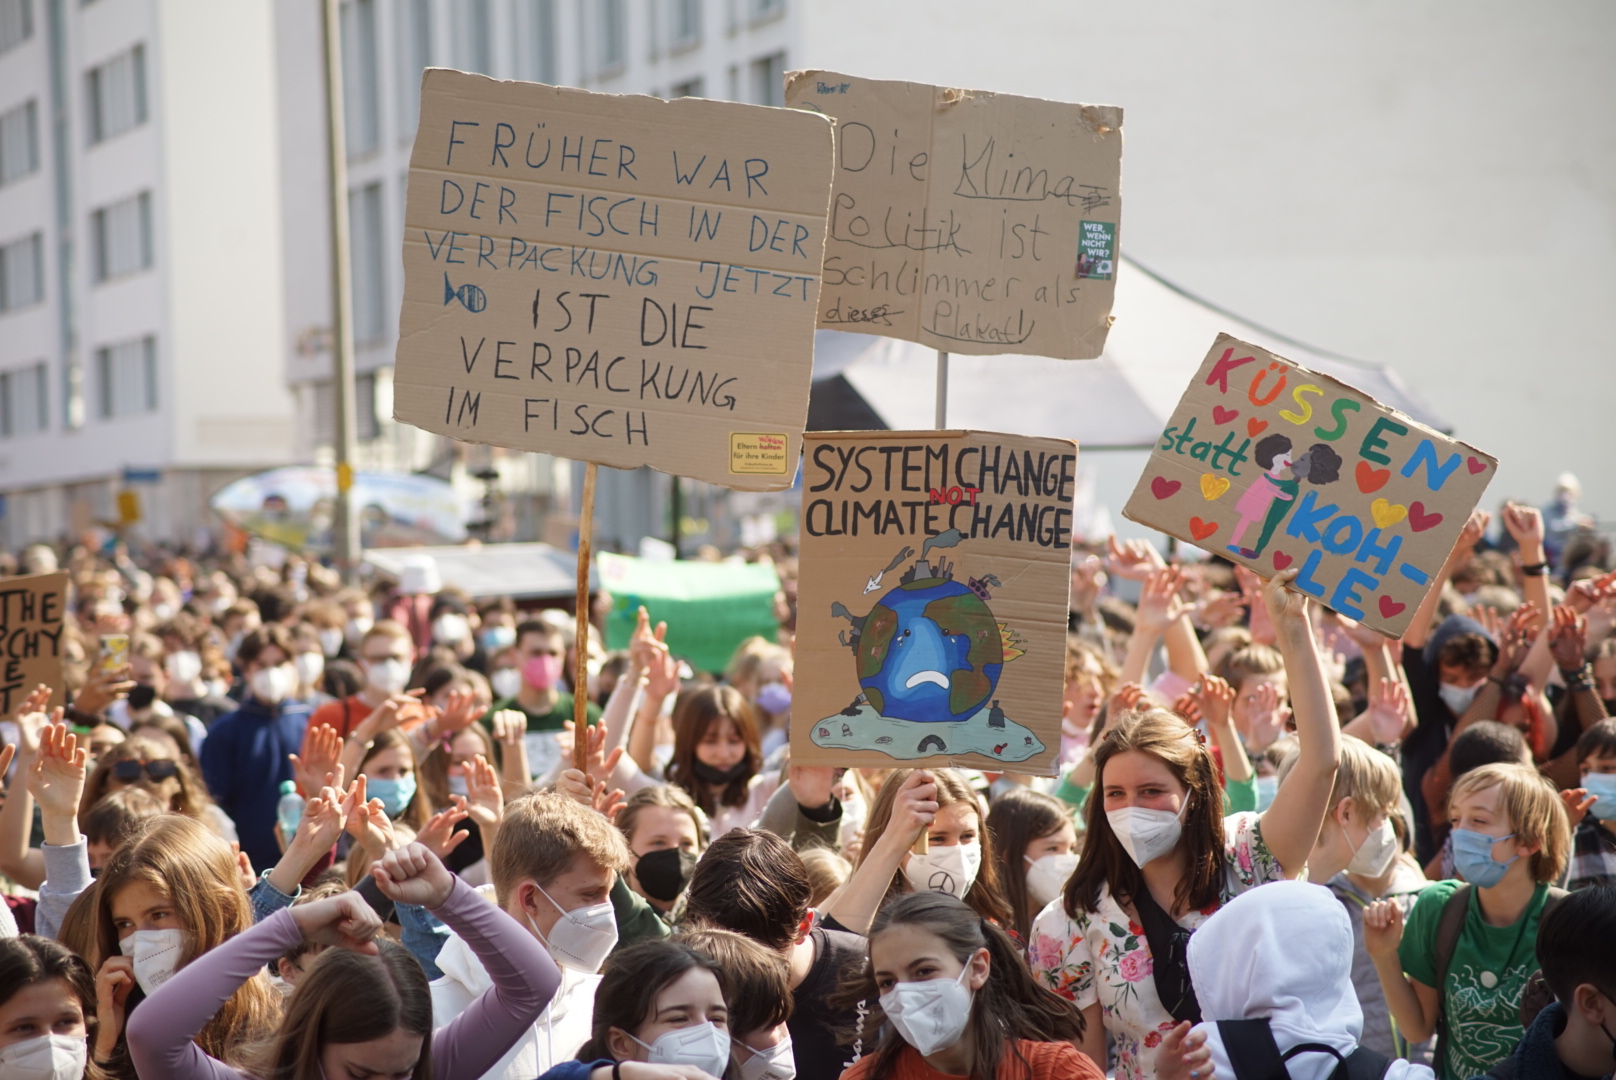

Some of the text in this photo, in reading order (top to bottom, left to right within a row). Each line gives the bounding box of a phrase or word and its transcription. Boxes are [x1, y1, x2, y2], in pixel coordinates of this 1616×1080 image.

[447, 120, 769, 198] FRÜHER WAR
[840, 121, 928, 182] Die
[440, 180, 809, 259] DER FISCH IN DER
[1081, 239, 1106, 248] NICHT
[1083, 222, 1105, 233] WER,
[1086, 232, 1111, 241] WENN
[424, 230, 815, 301] VERPACKUNG JETZT
[1087, 248, 1110, 257] WIR?
[532, 287, 714, 350] IST DIE
[1034, 274, 1081, 308] als
[460, 336, 738, 411] VERPACKUNG
[446, 385, 649, 446] IM FISCH
[1205, 347, 1463, 492] KÜSSEN
[733, 451, 743, 459] für
[810, 443, 1076, 503] SYSTEM CHANGE
[1160, 416, 1252, 477] statt
[806, 499, 1072, 549] CLIMATE CHANGE
[929, 485, 981, 507] NOT
[1286, 490, 1429, 587] KOH-
[0, 589, 60, 624] THE
[1295, 549, 1380, 622] LE
